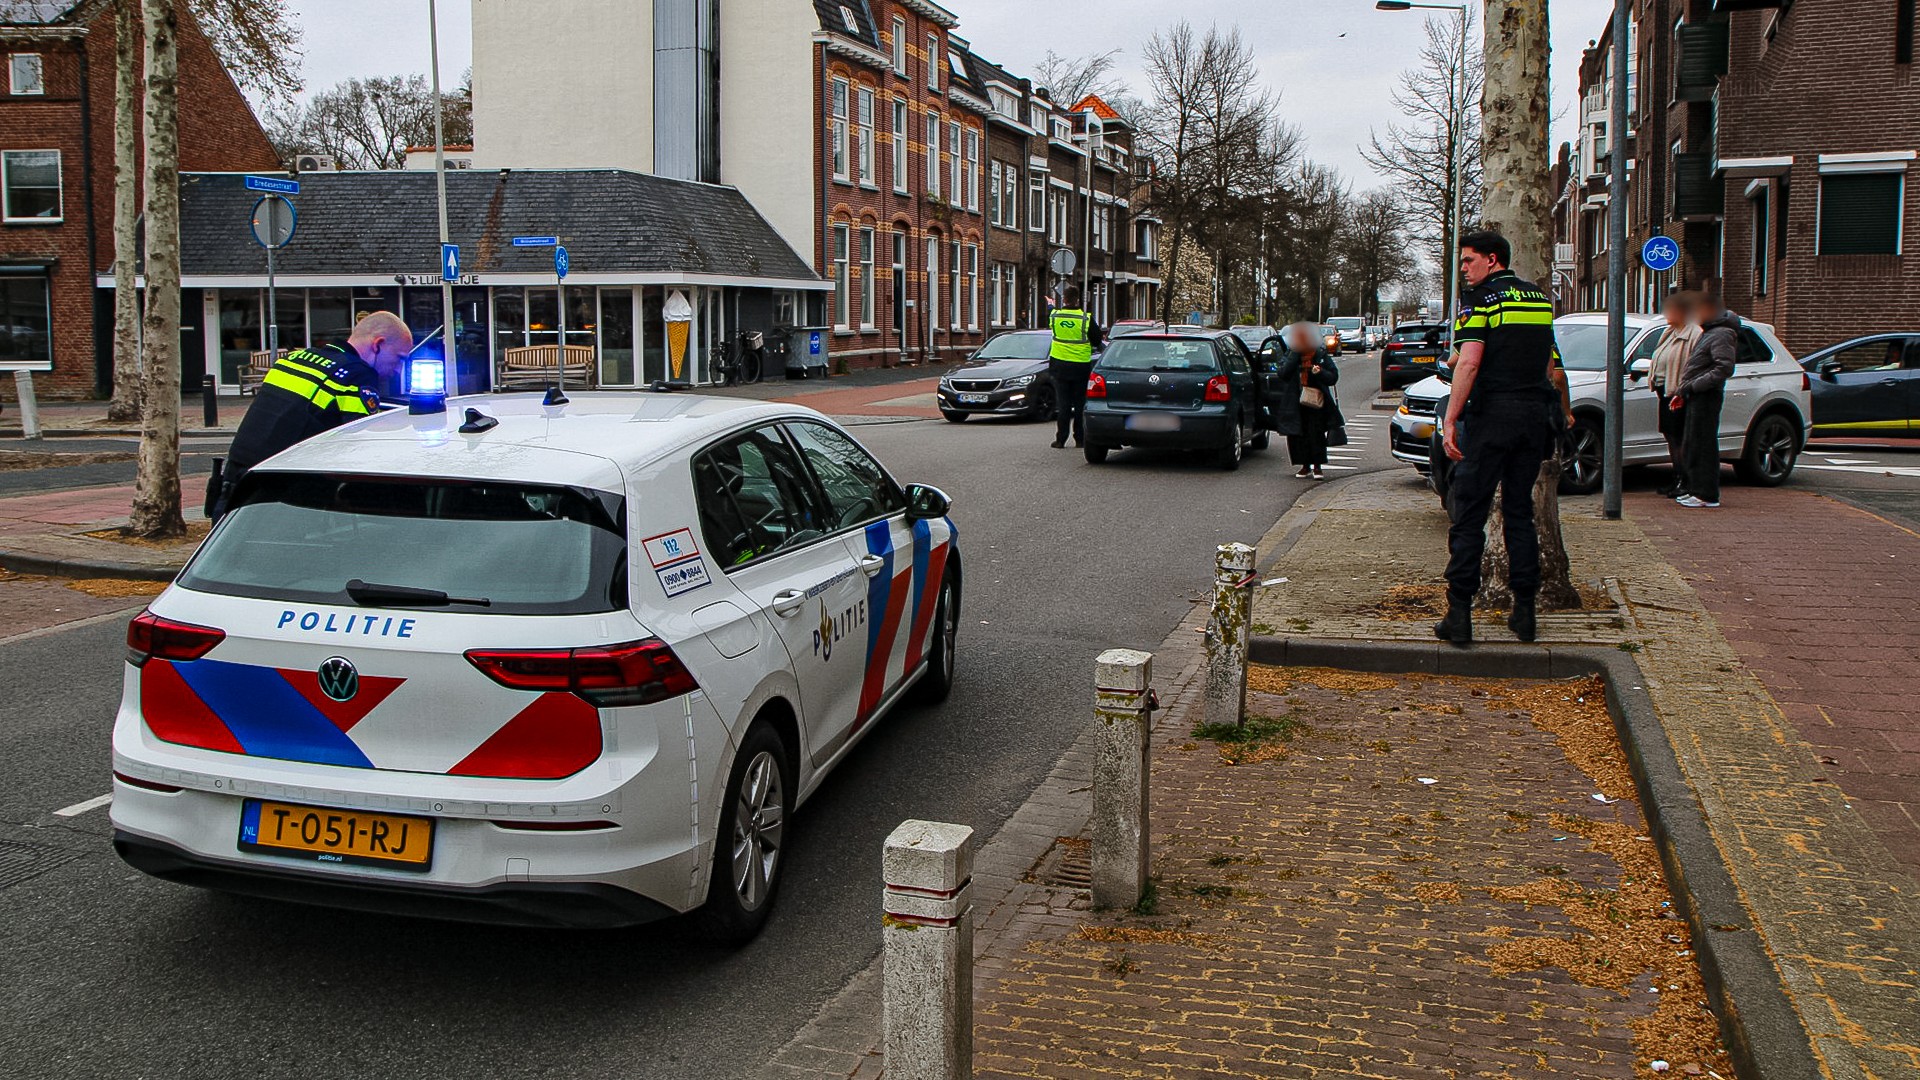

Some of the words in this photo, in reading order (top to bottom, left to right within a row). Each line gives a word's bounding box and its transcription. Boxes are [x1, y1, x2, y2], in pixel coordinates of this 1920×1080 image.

[663, 538, 680, 554] 112
[664, 572, 681, 586] 0900
[277, 610, 416, 638] POLITIE
[813, 600, 865, 662] POLITIE
[244, 825, 256, 837] NL
[273, 809, 409, 855] T-051-RJ
[318, 855, 343, 863] politie.nl
